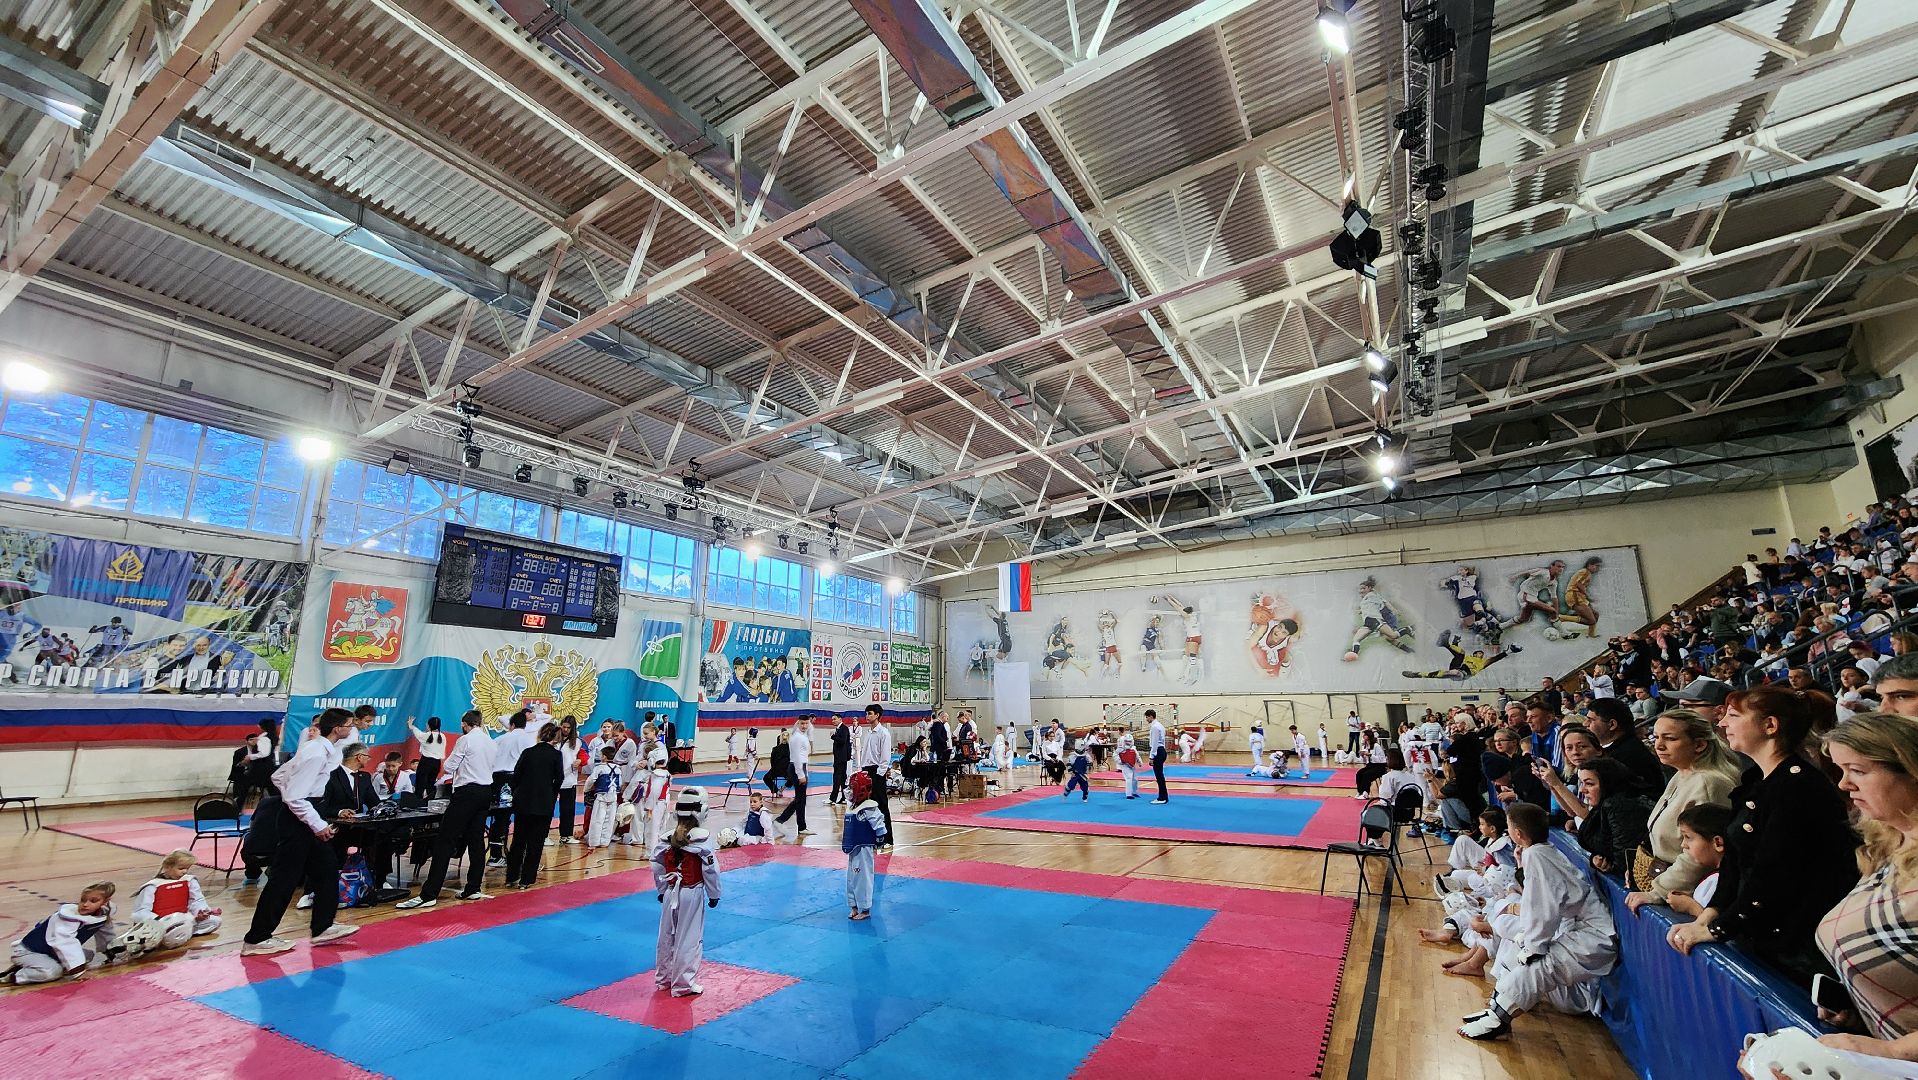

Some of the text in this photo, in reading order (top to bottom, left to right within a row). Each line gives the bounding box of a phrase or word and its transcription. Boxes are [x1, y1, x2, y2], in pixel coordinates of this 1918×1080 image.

[115, 596, 168, 608] ПРОТВИНО
[562, 620, 598, 633] ИМПУЛЬС
[735, 626, 786, 646] ГАНДБОЛ
[743, 645, 784, 654] ПРОТВИНО
[28, 664, 129, 688] СПОРТА
[143, 668, 158, 689] В
[170, 668, 280, 689] ПРОТВИНО
[839, 678, 866, 697] ЭРИДАН
[635, 700, 679, 709] АДМИНИСТРАЦИЯ
